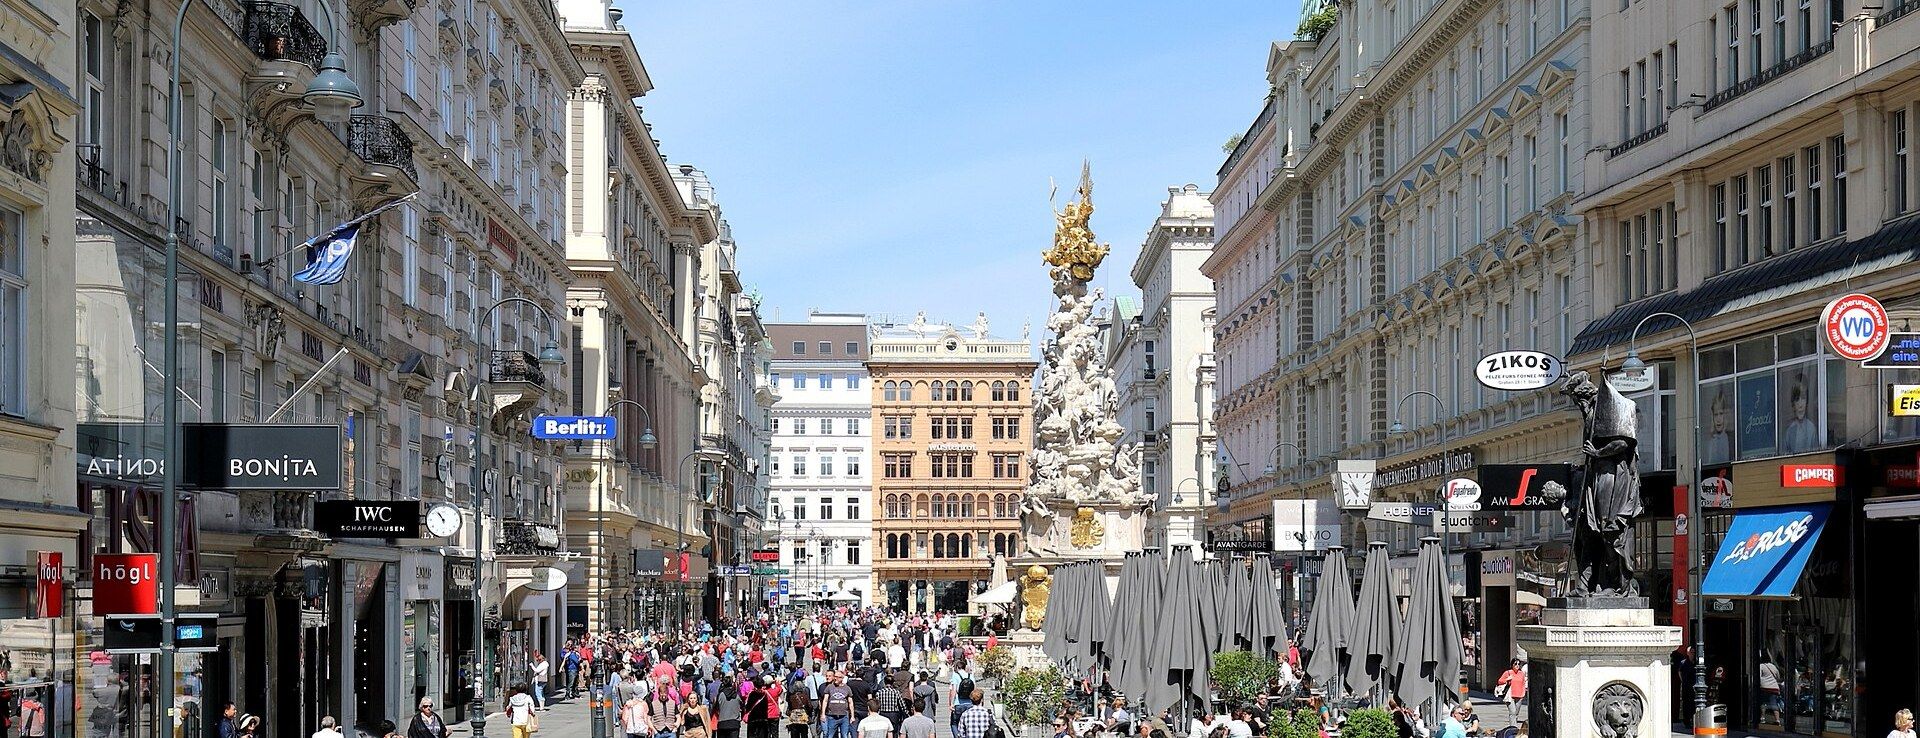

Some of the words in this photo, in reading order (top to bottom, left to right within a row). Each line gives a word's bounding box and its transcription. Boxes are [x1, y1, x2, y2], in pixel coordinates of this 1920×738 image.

[1843, 316, 1874, 338] VVD
[1487, 355, 1552, 373] ZIKOS
[1892, 351, 1919, 362] eine
[545, 420, 608, 435] Berlitz
[1795, 468, 1834, 483] CAMPER
[1491, 496, 1508, 506] AM
[354, 506, 392, 522] IWC
[1441, 514, 1489, 526] swatch
[1216, 541, 1267, 549] AVANTGARDE
